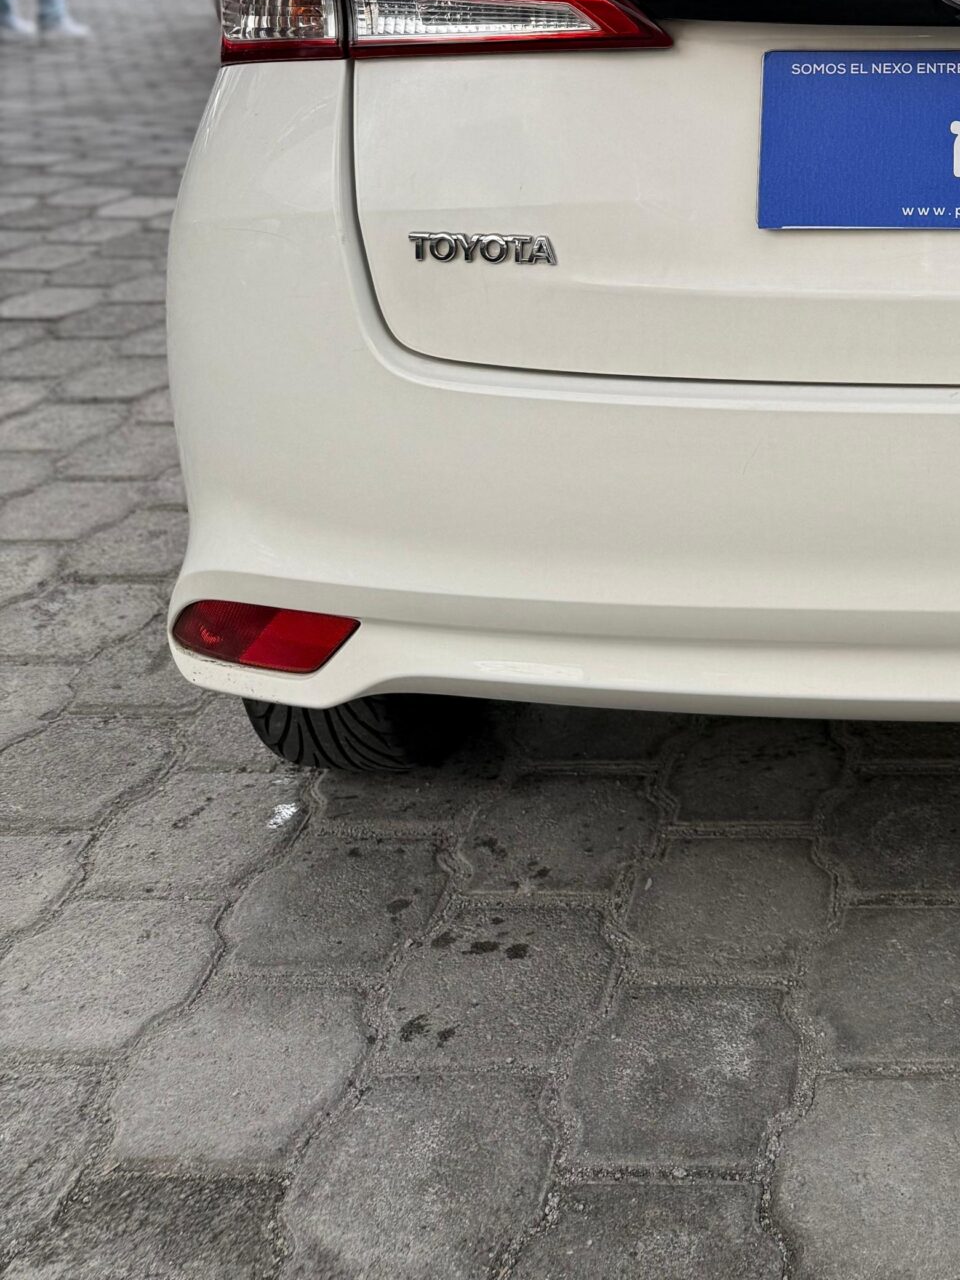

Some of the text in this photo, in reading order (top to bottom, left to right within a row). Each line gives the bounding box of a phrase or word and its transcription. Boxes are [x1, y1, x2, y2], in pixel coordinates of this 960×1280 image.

[791, 63, 847, 75] SOMOS
[850, 63, 868, 74] EL
[871, 62, 913, 74] NEXO
[408, 231, 557, 266] TOYOTA
